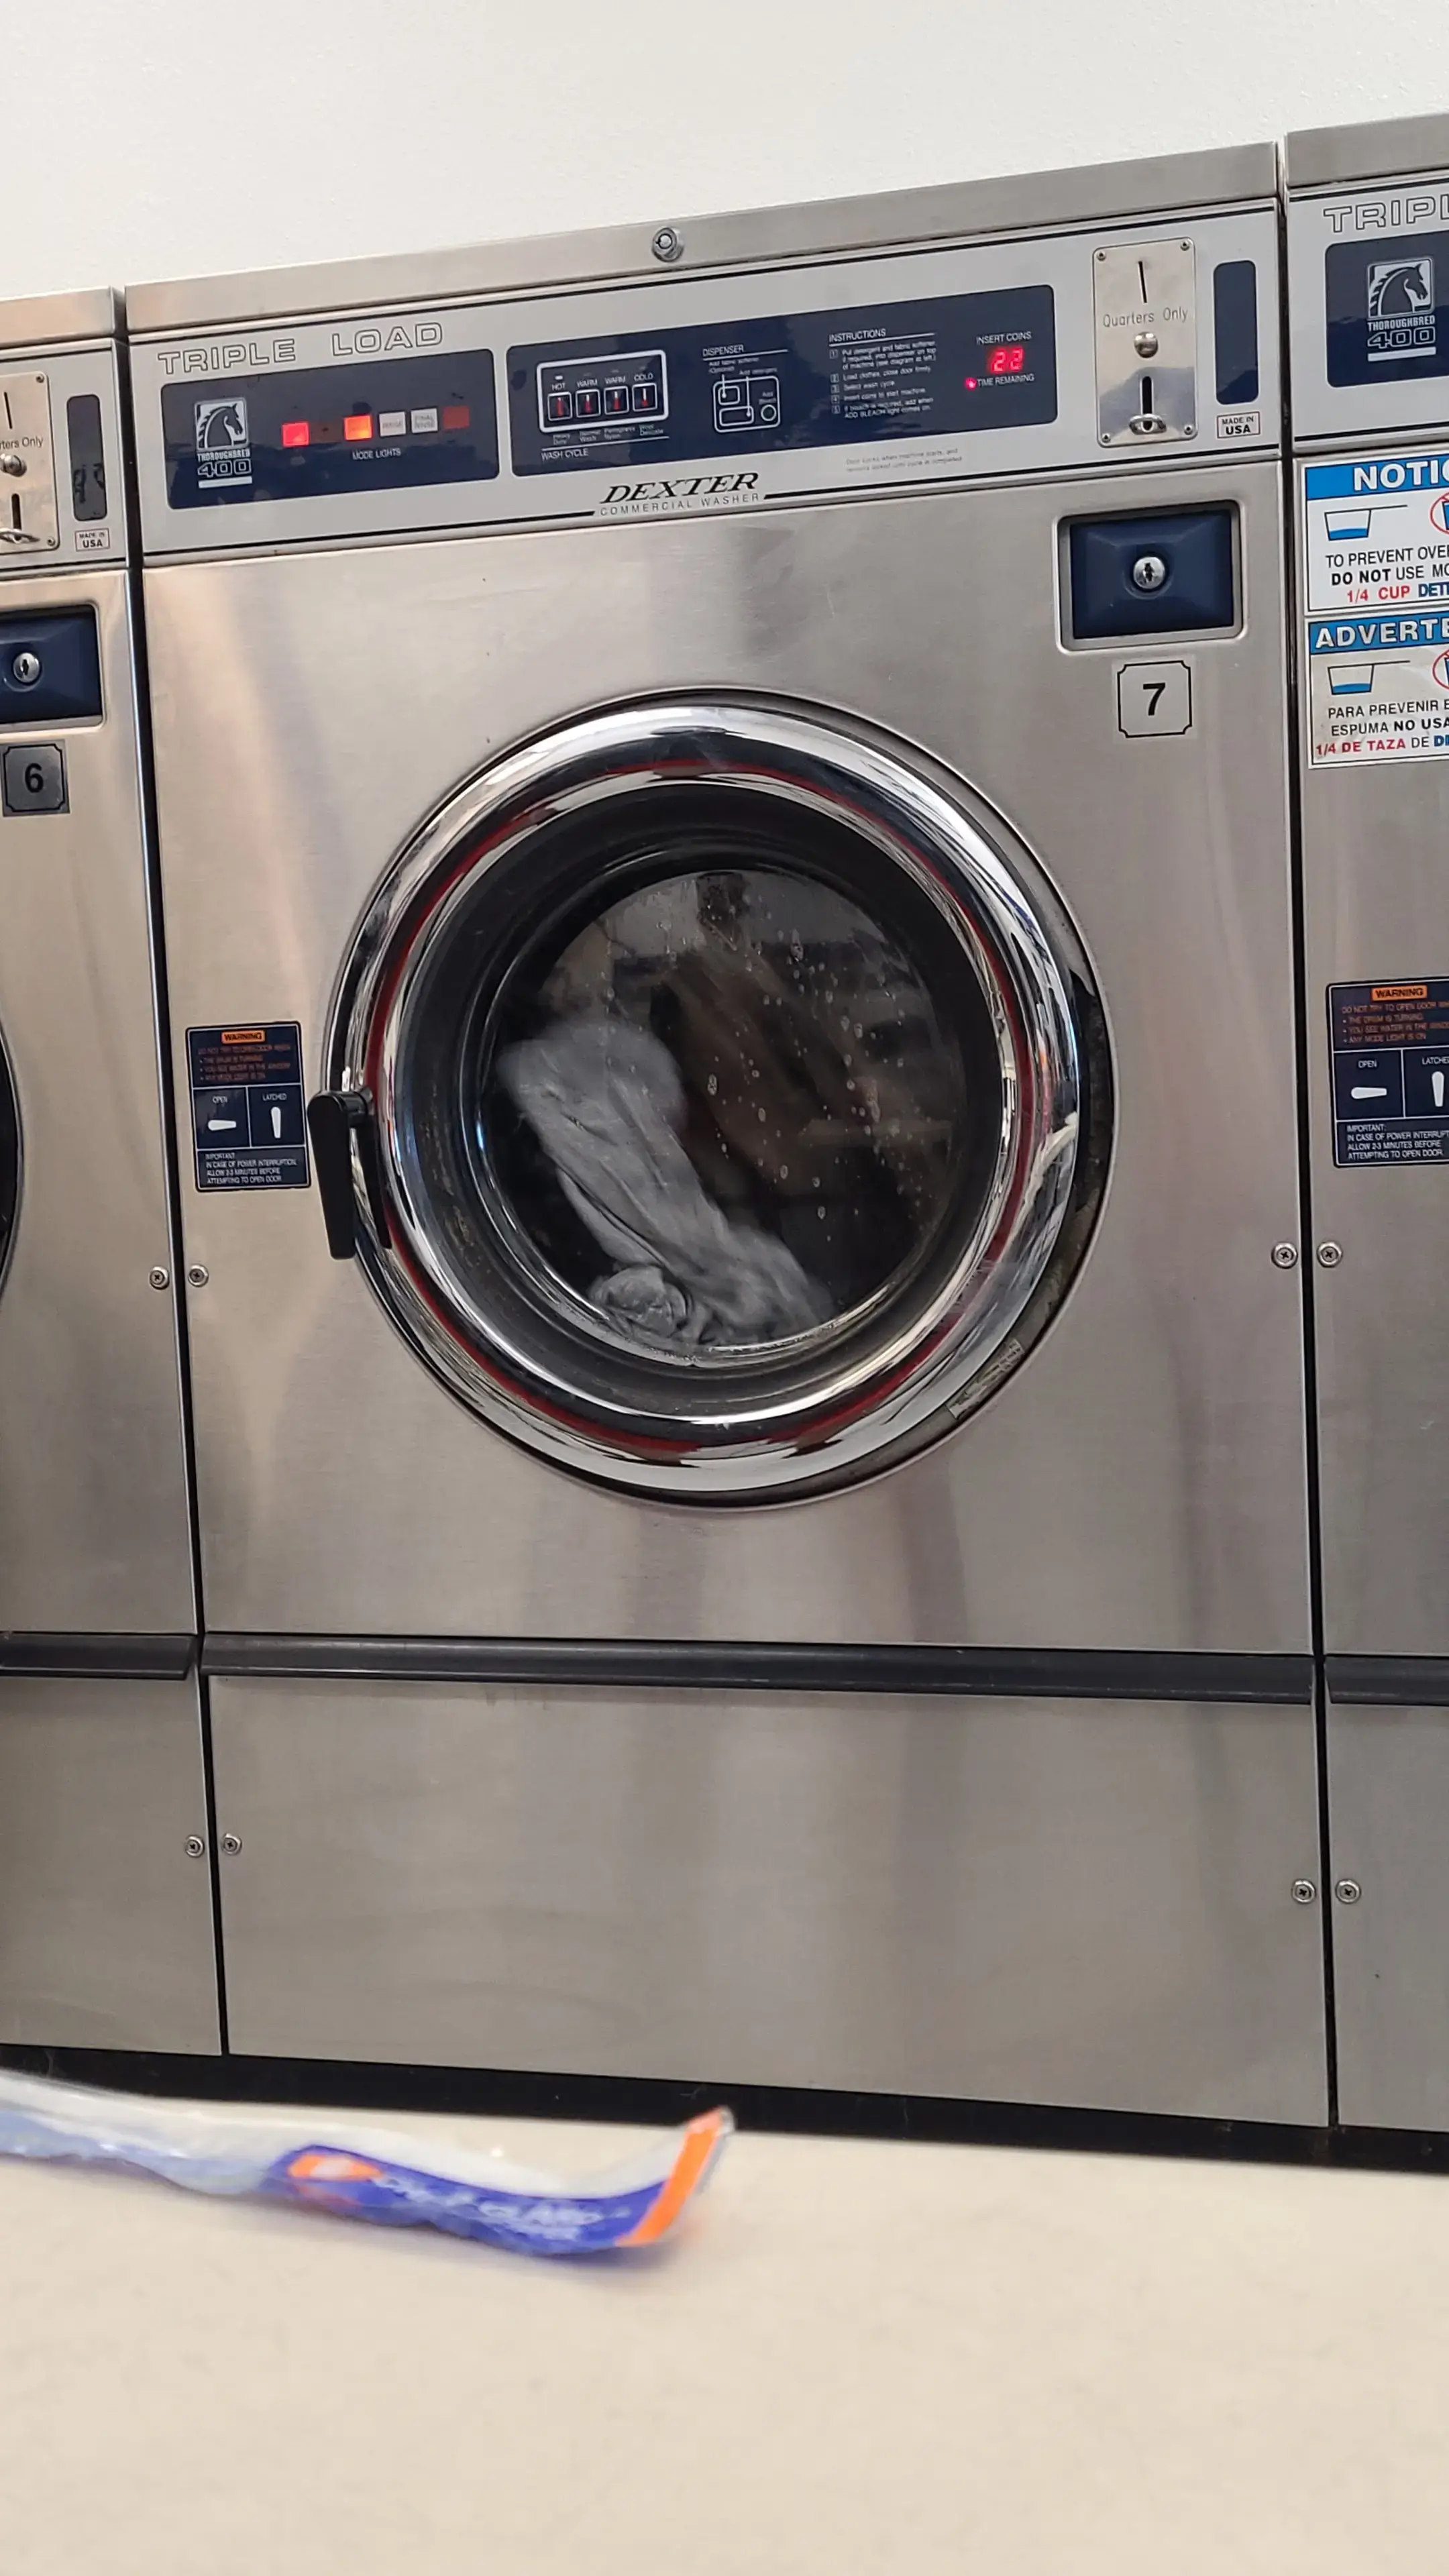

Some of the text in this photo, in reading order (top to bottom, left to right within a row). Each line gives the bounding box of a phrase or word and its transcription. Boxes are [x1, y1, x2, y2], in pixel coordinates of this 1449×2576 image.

[1103, 306, 1188, 327] Quarters Only
[1367, 315, 1436, 331] THOROUGHBRED
[829, 328, 886, 342] INSTRUCTIONS
[976, 331, 1032, 345] INSERT COINS
[1367, 326, 1436, 349] 400
[158, 323, 443, 374] TRIPLE LOAD
[702, 344, 744, 357] DISPENSER
[992, 348, 1023, 372] 22
[576, 379, 598, 388] WARM
[605, 376, 626, 384] WARM
[634, 372, 653, 381] COLD
[977, 374, 1034, 387] TIME REMAINING
[551, 382, 566, 391] HOT
[1222, 417, 1244, 425] MADE
[1226, 424, 1251, 435] USA
[22, 436, 44, 449] Only
[352, 448, 401, 460] MODE LIGHTS
[541, 448, 588, 462] WASH CYCLE
[197, 458, 252, 478] 400
[1353, 459, 1449, 491] NOTI
[599, 472, 759, 504] DEXTER
[600, 493, 759, 516] COMMERCIAL WASHER
[83, 539, 103, 548] USA
[1326, 554, 1344, 568] TO
[1348, 547, 1413, 566] PREVENT
[1332, 572, 1352, 586] DO
[1359, 568, 1391, 584] NOT
[1396, 566, 1424, 580] USE
[1347, 588, 1369, 604] 1/4
[1378, 585, 1411, 600] CUP
[1142, 682, 1166, 716] 7
[1328, 705, 1365, 719] PARA
[1369, 700, 1439, 716] PREVENIR
[1332, 722, 1389, 737] ESPUMA
[1394, 719, 1415, 732] NO
[1316, 743, 1336, 756] 1/4
[1342, 741, 1361, 753] DE
[1366, 738, 1406, 751] TAZA
[1411, 737, 1430, 749] DE
[25, 763, 44, 793] 6
[1375, 987, 1424, 998] WARNING
[224, 1032, 262, 1042] WARNING
[1358, 1060, 1377, 1068] OPEN
[212, 1095, 228, 1104] OPEN
[262, 1093, 287, 1102] LATCHED
[1356, 1133, 1374, 1141] CASE
[1375, 1132, 1385, 1140] OF
[1387, 1132, 1411, 1140] POWER
[1348, 1142, 1371, 1150] ALLOW
[1383, 1141, 1412, 1149] MINUTES
[1414, 1140, 1441, 1148] BEFORE
[1348, 1150, 1389, 1160] ATTEMPTING
[1402, 1149, 1421, 1158] OPEN
